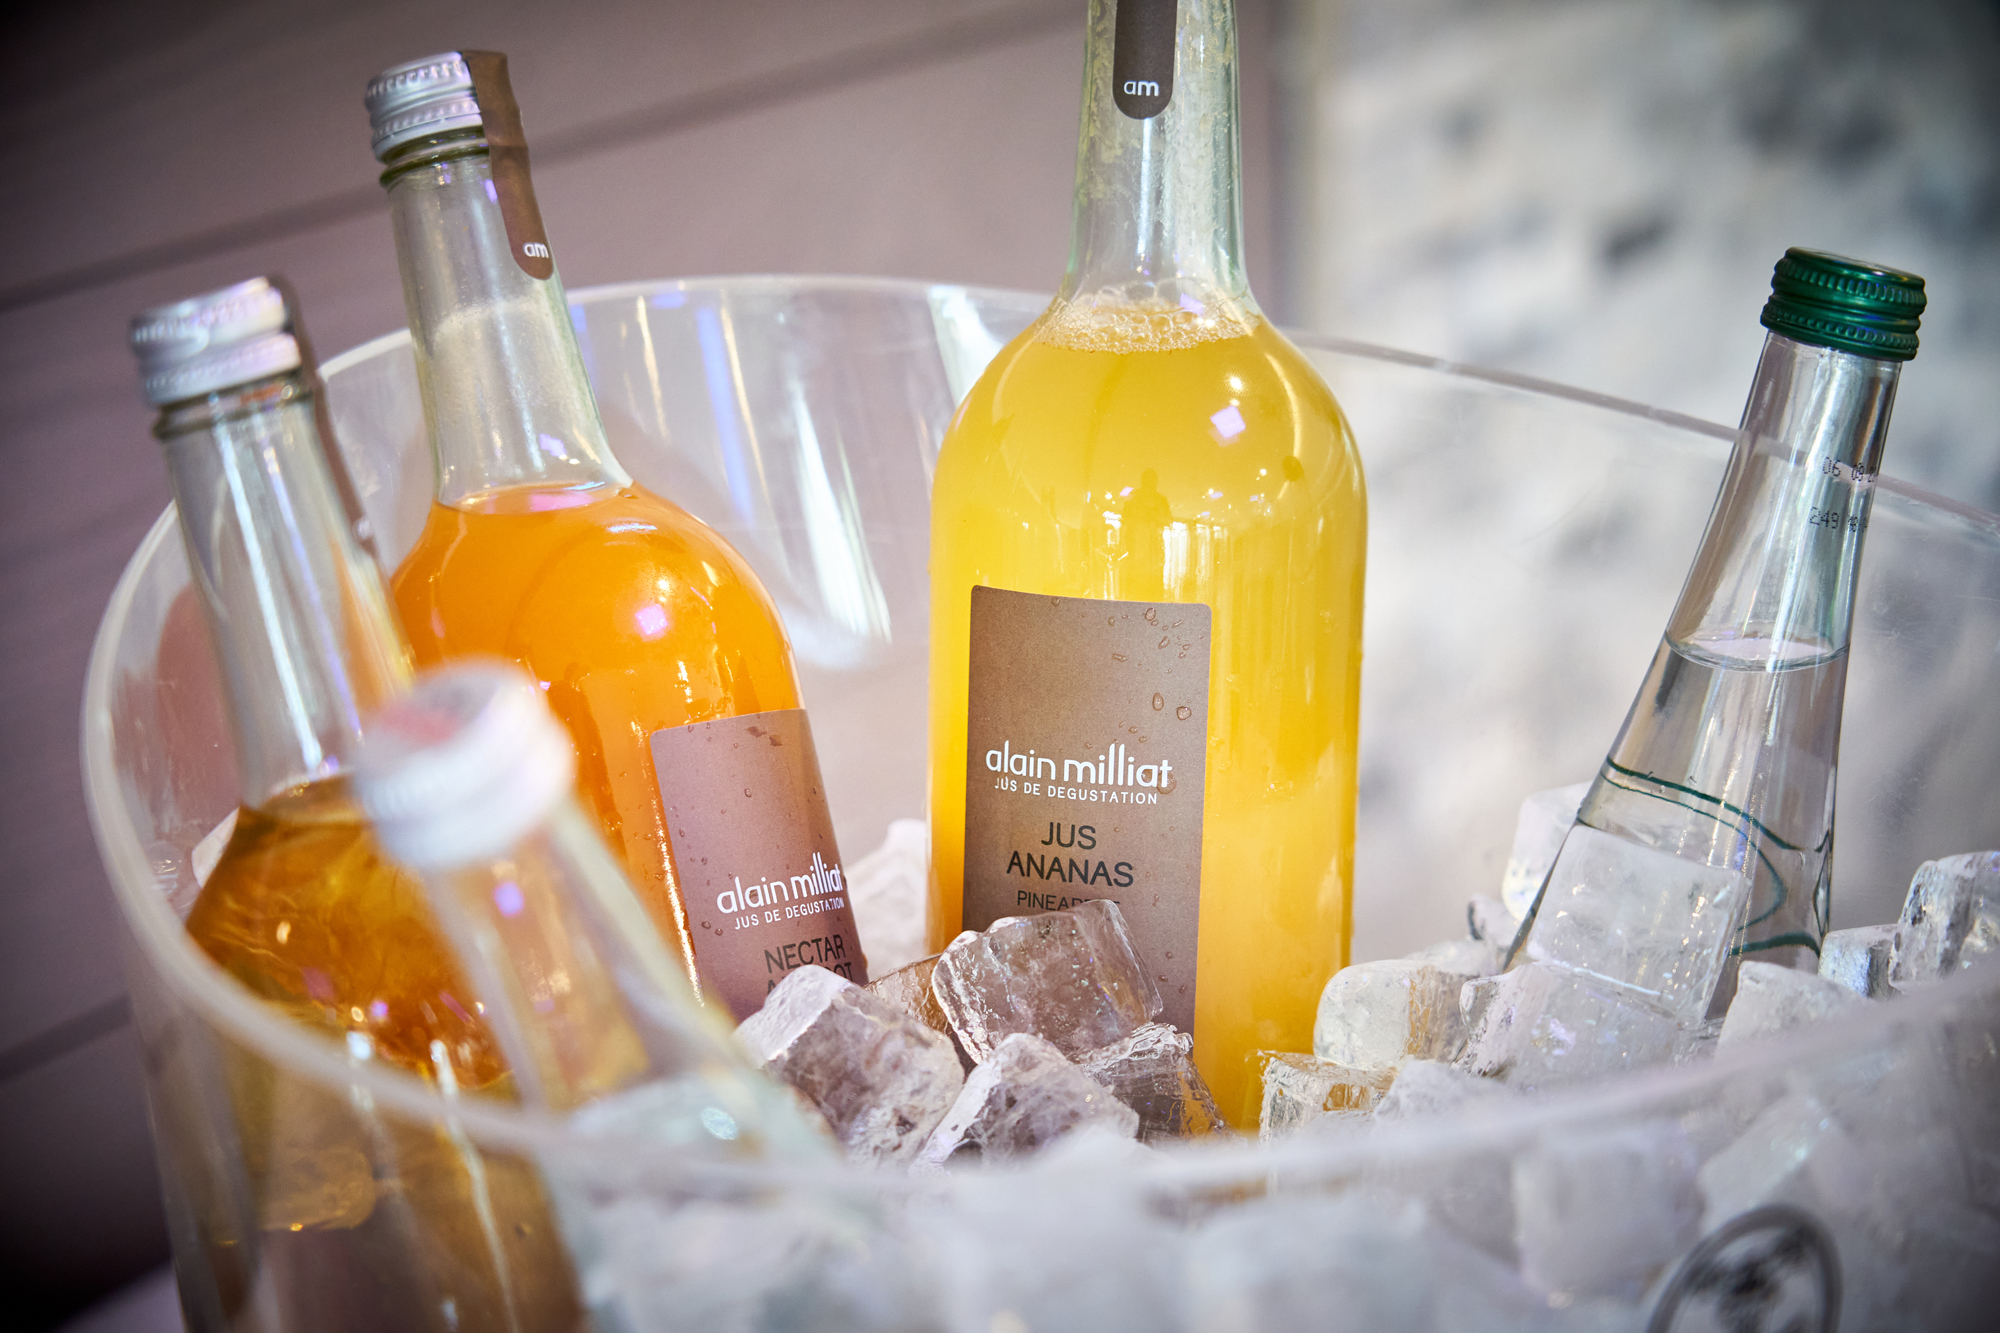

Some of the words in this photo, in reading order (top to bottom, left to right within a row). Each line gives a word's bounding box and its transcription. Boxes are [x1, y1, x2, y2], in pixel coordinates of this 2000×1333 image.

[1123, 80, 1159, 97] am
[523, 242, 549, 259] am
[1822, 456, 1841, 477] 06
[1809, 506, 1840, 529] 249
[985, 740, 1056, 781] alain
[1063, 743, 1173, 788] milliat
[994, 777, 1017, 792] JUS
[1024, 782, 1041, 796] DE
[1047, 785, 1157, 805] DEGUSTATION
[1041, 821, 1096, 850] JUS
[716, 876, 789, 914] alain
[790, 851, 843, 898] milliat
[1006, 850, 1134, 888] ANANAS
[734, 913, 759, 930] JUS
[764, 909, 781, 924] DE
[785, 897, 845, 919] DEGUSTATION
[764, 933, 846, 974] NECTAR
